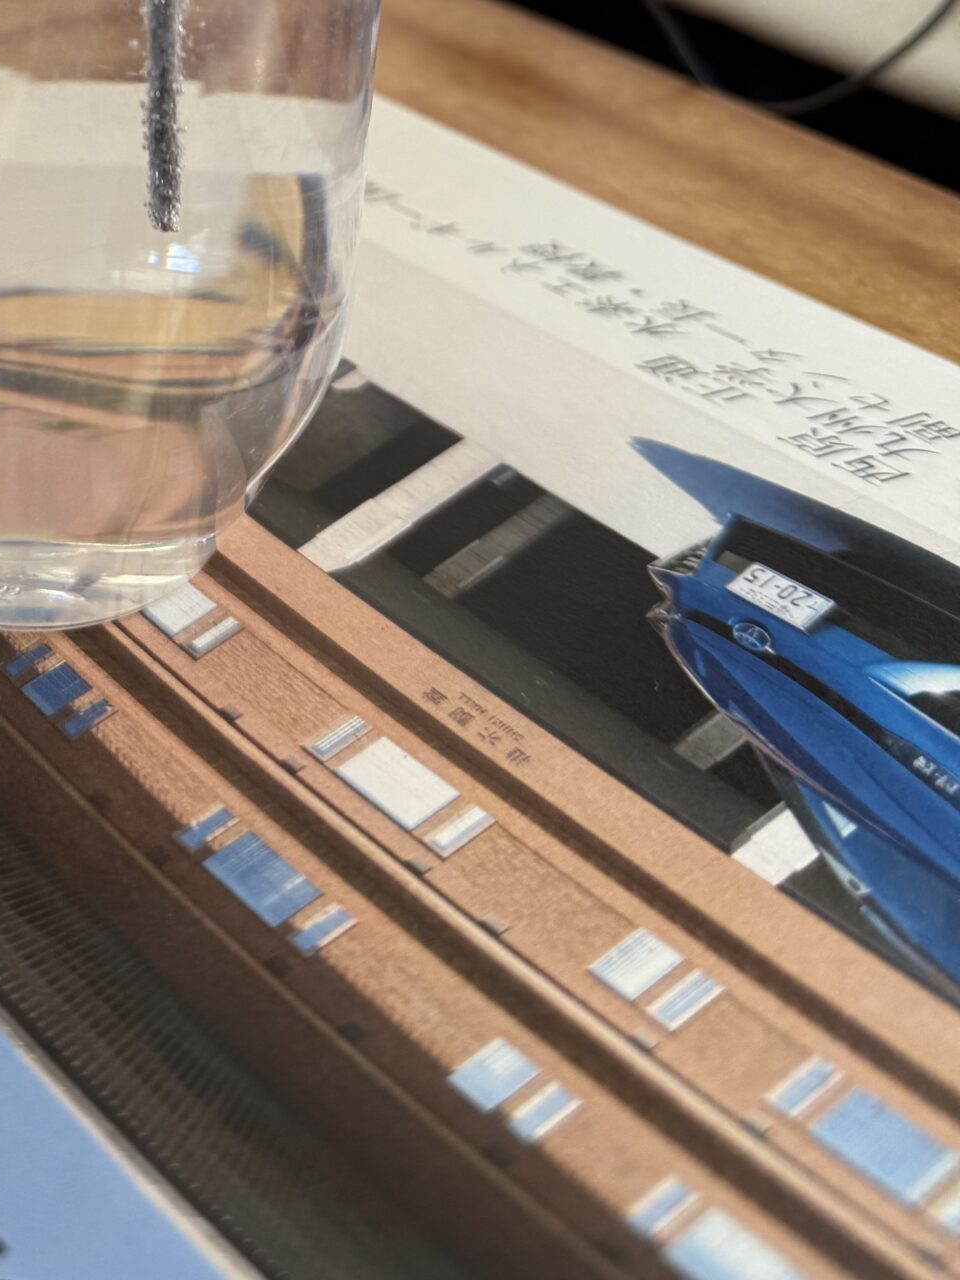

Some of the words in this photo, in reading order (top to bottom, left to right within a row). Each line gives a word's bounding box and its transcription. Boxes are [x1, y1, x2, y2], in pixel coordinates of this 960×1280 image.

[711, 361, 943, 461] 九州大学
[775, 425, 912, 487] 西原
[458, 692, 488, 716] HALL
